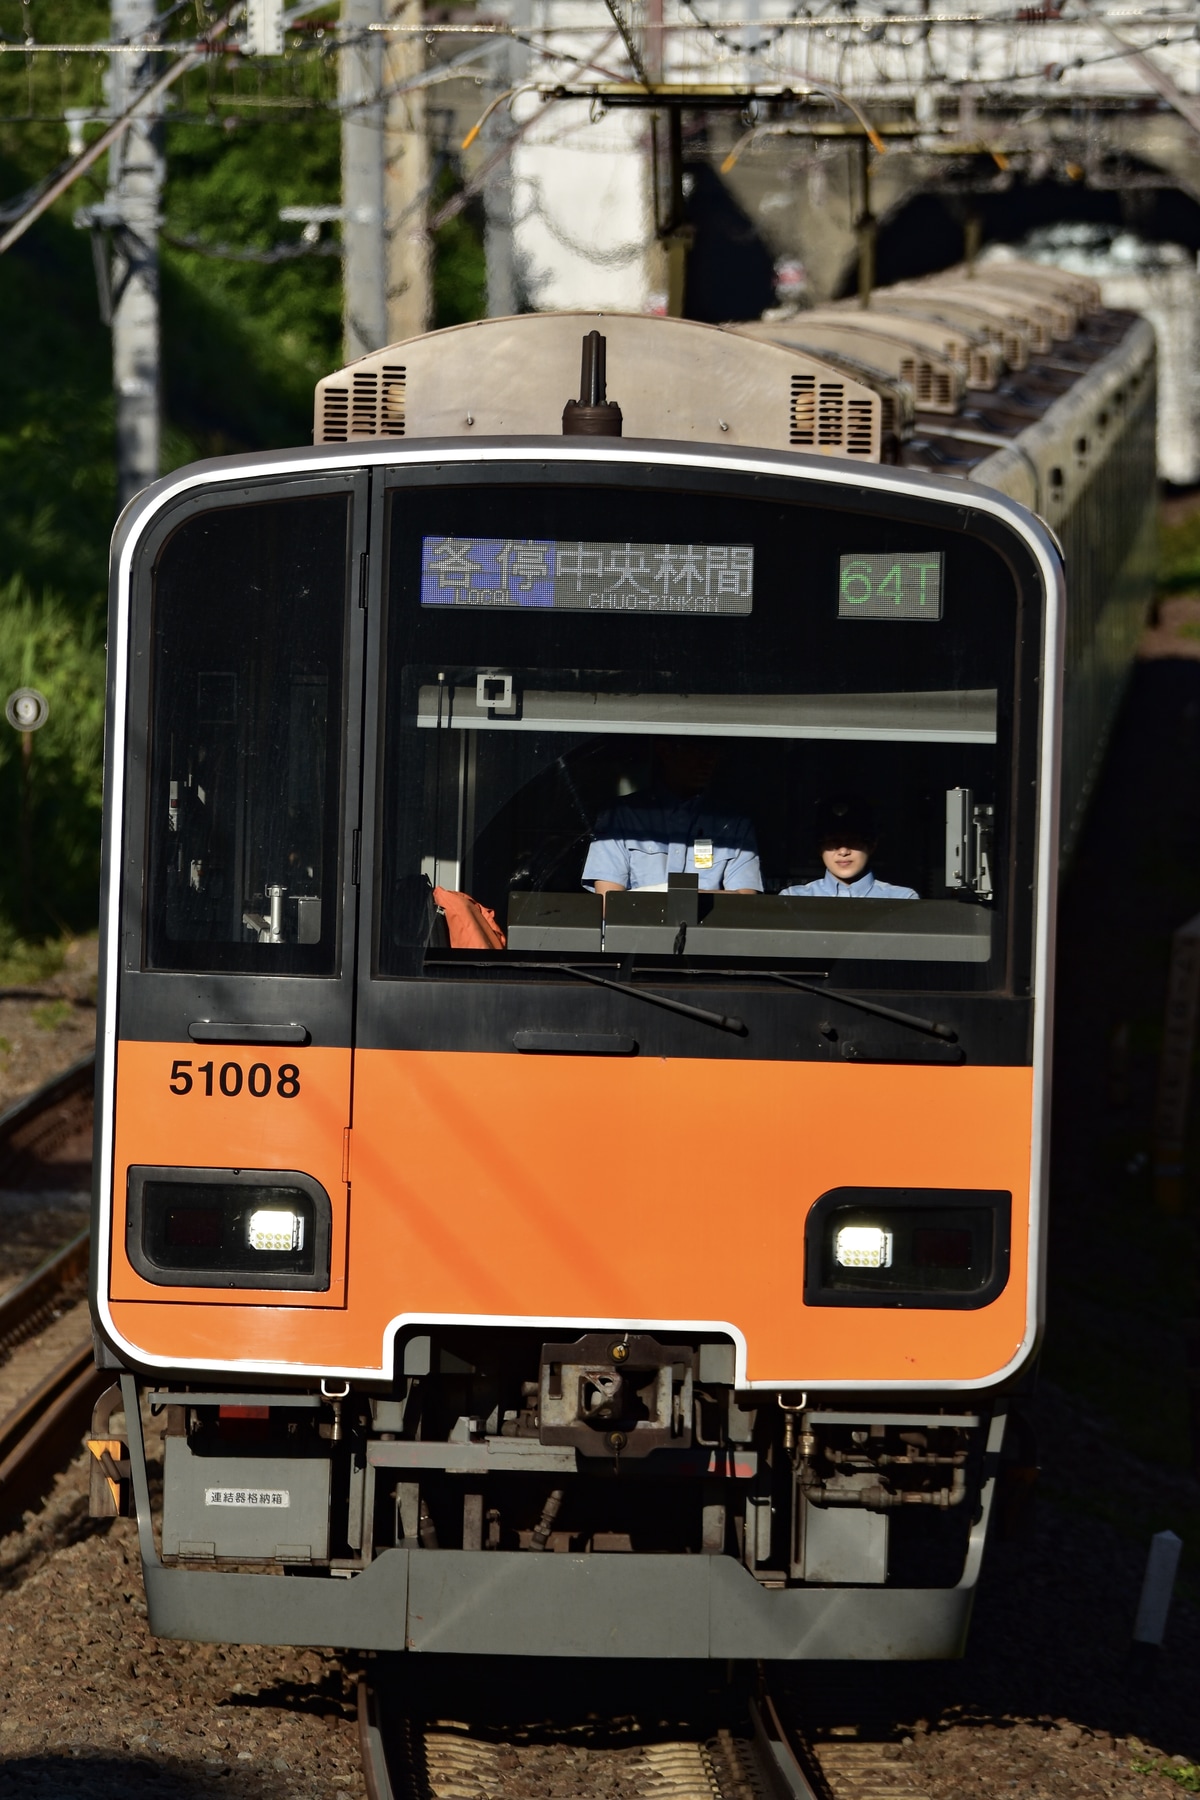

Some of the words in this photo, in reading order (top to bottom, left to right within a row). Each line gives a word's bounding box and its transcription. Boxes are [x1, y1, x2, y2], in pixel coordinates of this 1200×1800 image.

[556, 541, 752, 596] 中央林間
[841, 561, 940, 605] 64T
[456, 588, 518, 606] LOCAL
[588, 592, 718, 613] CHUO-RINKAN
[169, 1060, 301, 1099] 51008
[210, 1491, 283, 1505] 連結器格納箱
